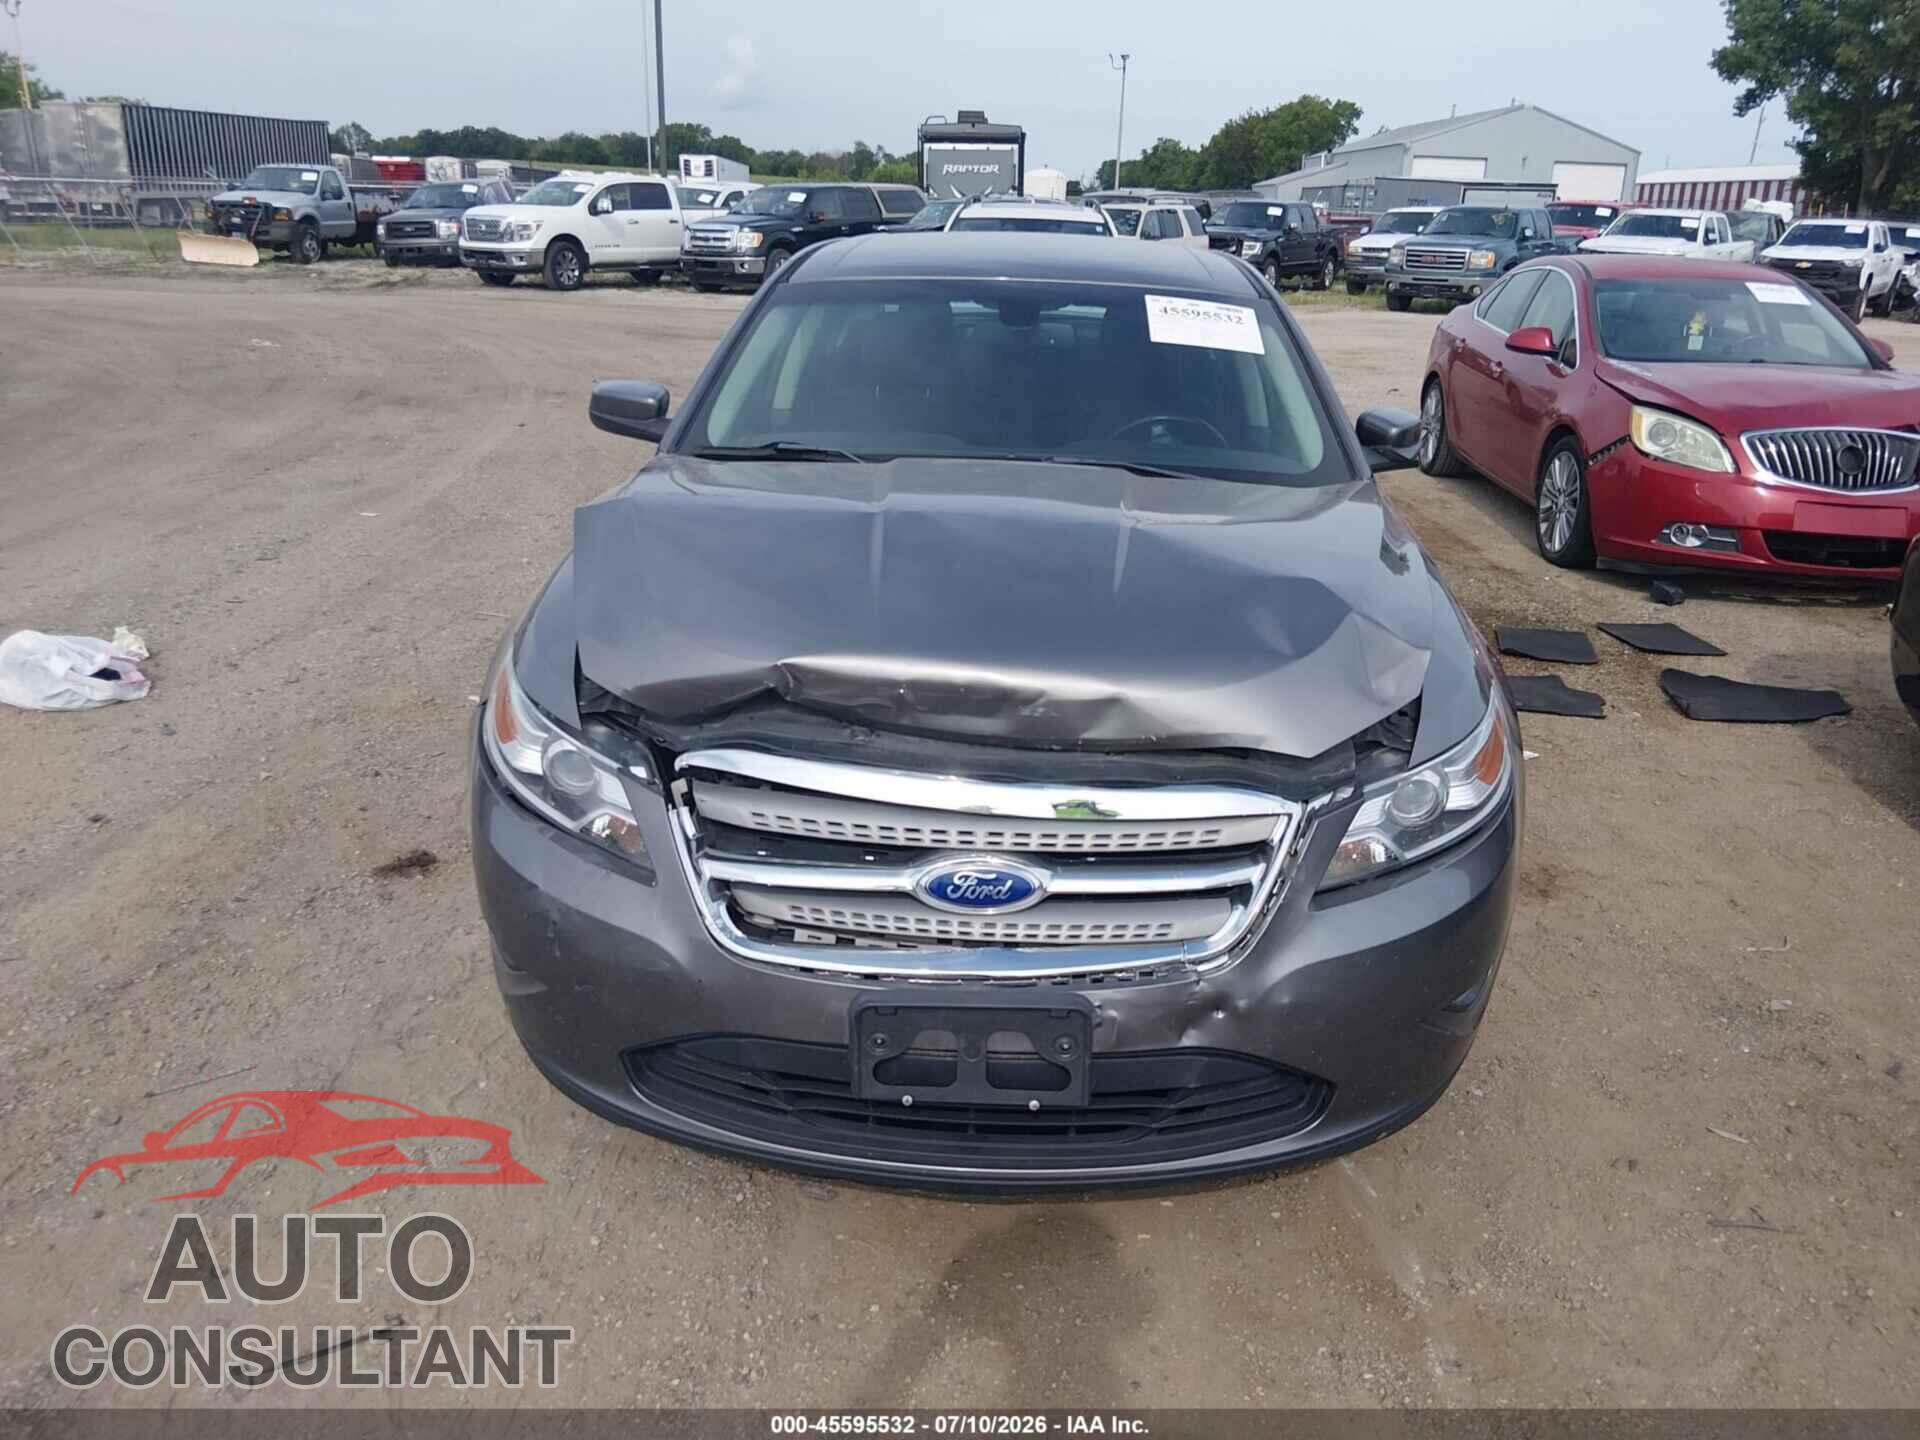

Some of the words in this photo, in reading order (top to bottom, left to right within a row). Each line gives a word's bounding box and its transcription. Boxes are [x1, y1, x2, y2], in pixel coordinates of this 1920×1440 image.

[942, 163, 1001, 176] RAPTOR
[1159, 305, 1246, 325] 45595532
[946, 871, 1013, 899] Ford
